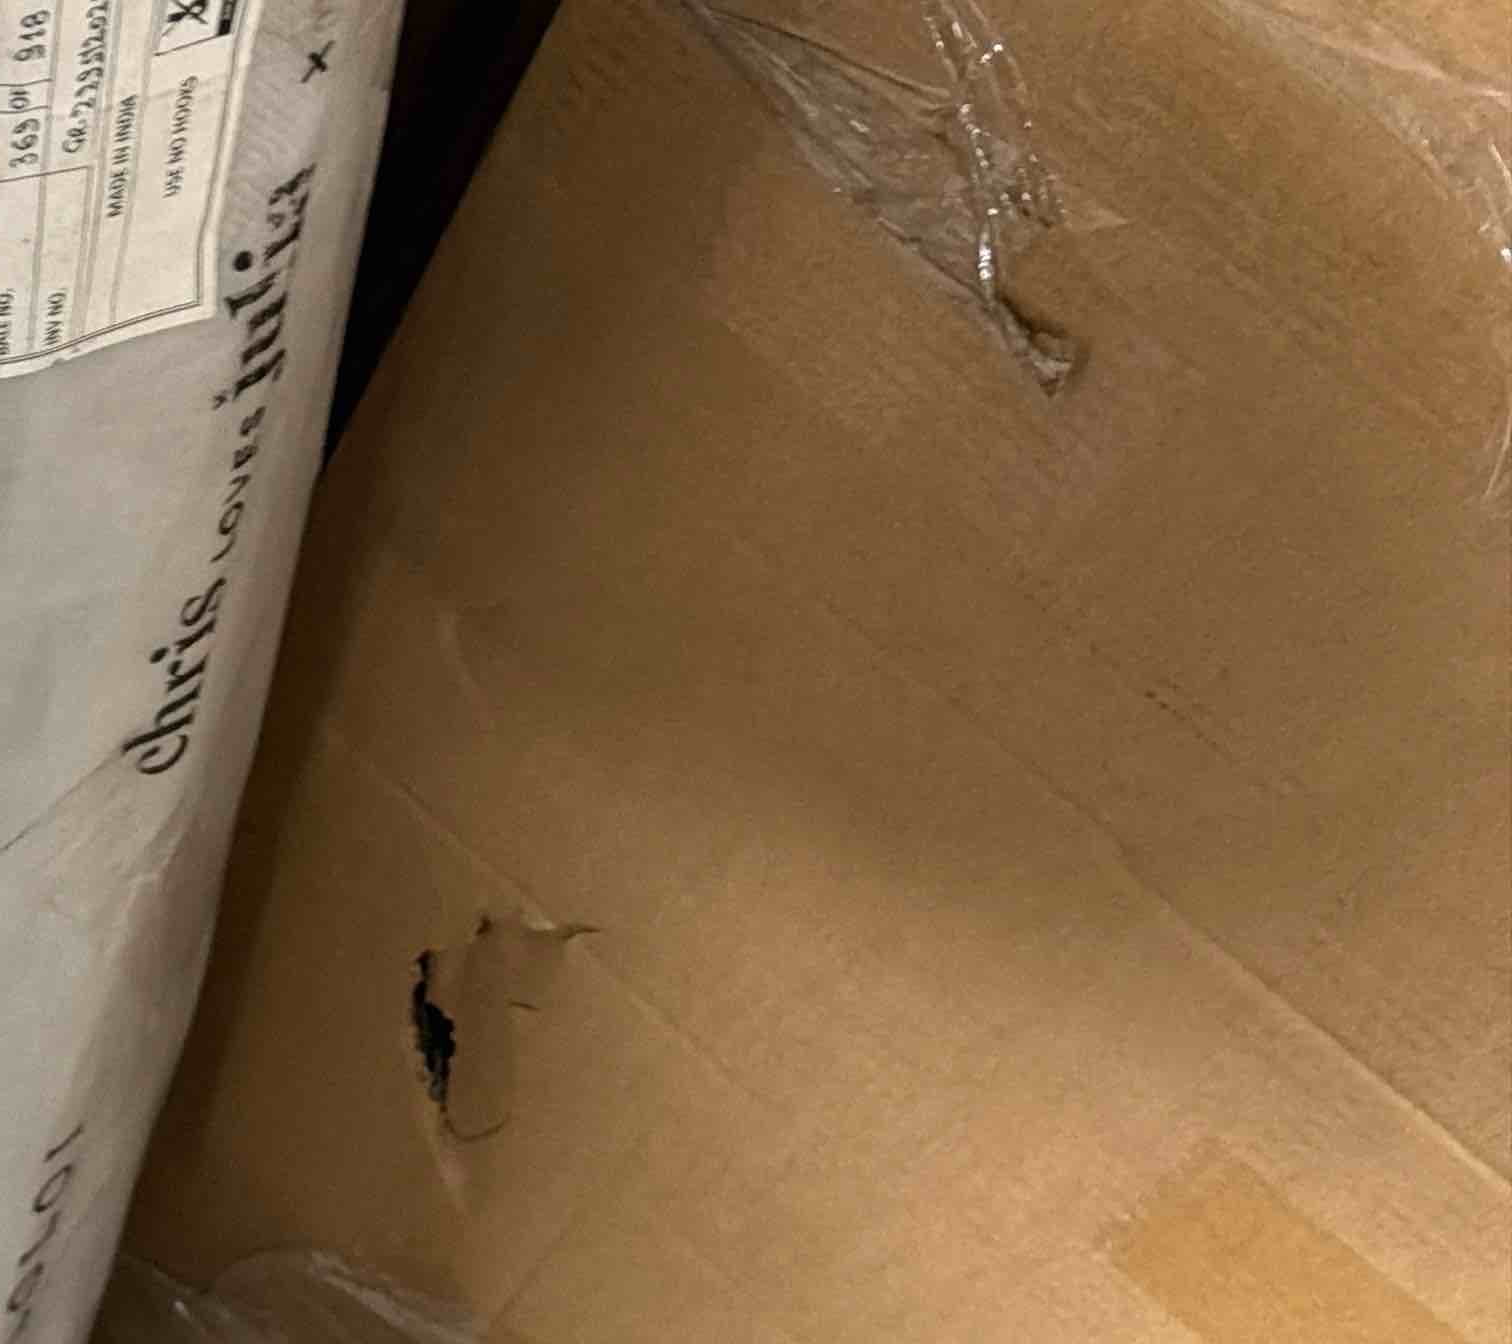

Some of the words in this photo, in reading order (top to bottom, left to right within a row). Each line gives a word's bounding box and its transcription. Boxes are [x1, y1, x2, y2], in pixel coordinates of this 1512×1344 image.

[114, 93, 138, 144] INDIA
[168, 74, 199, 134] HOOKS
[112, 145, 130, 165] IN
[164, 137, 188, 165] NO
[106, 166, 129, 219] MADE
[162, 166, 185, 198] USE
[42, 320, 62, 347] INV
[130, 575, 229, 776] chris
[206, 159, 319, 412] julia
